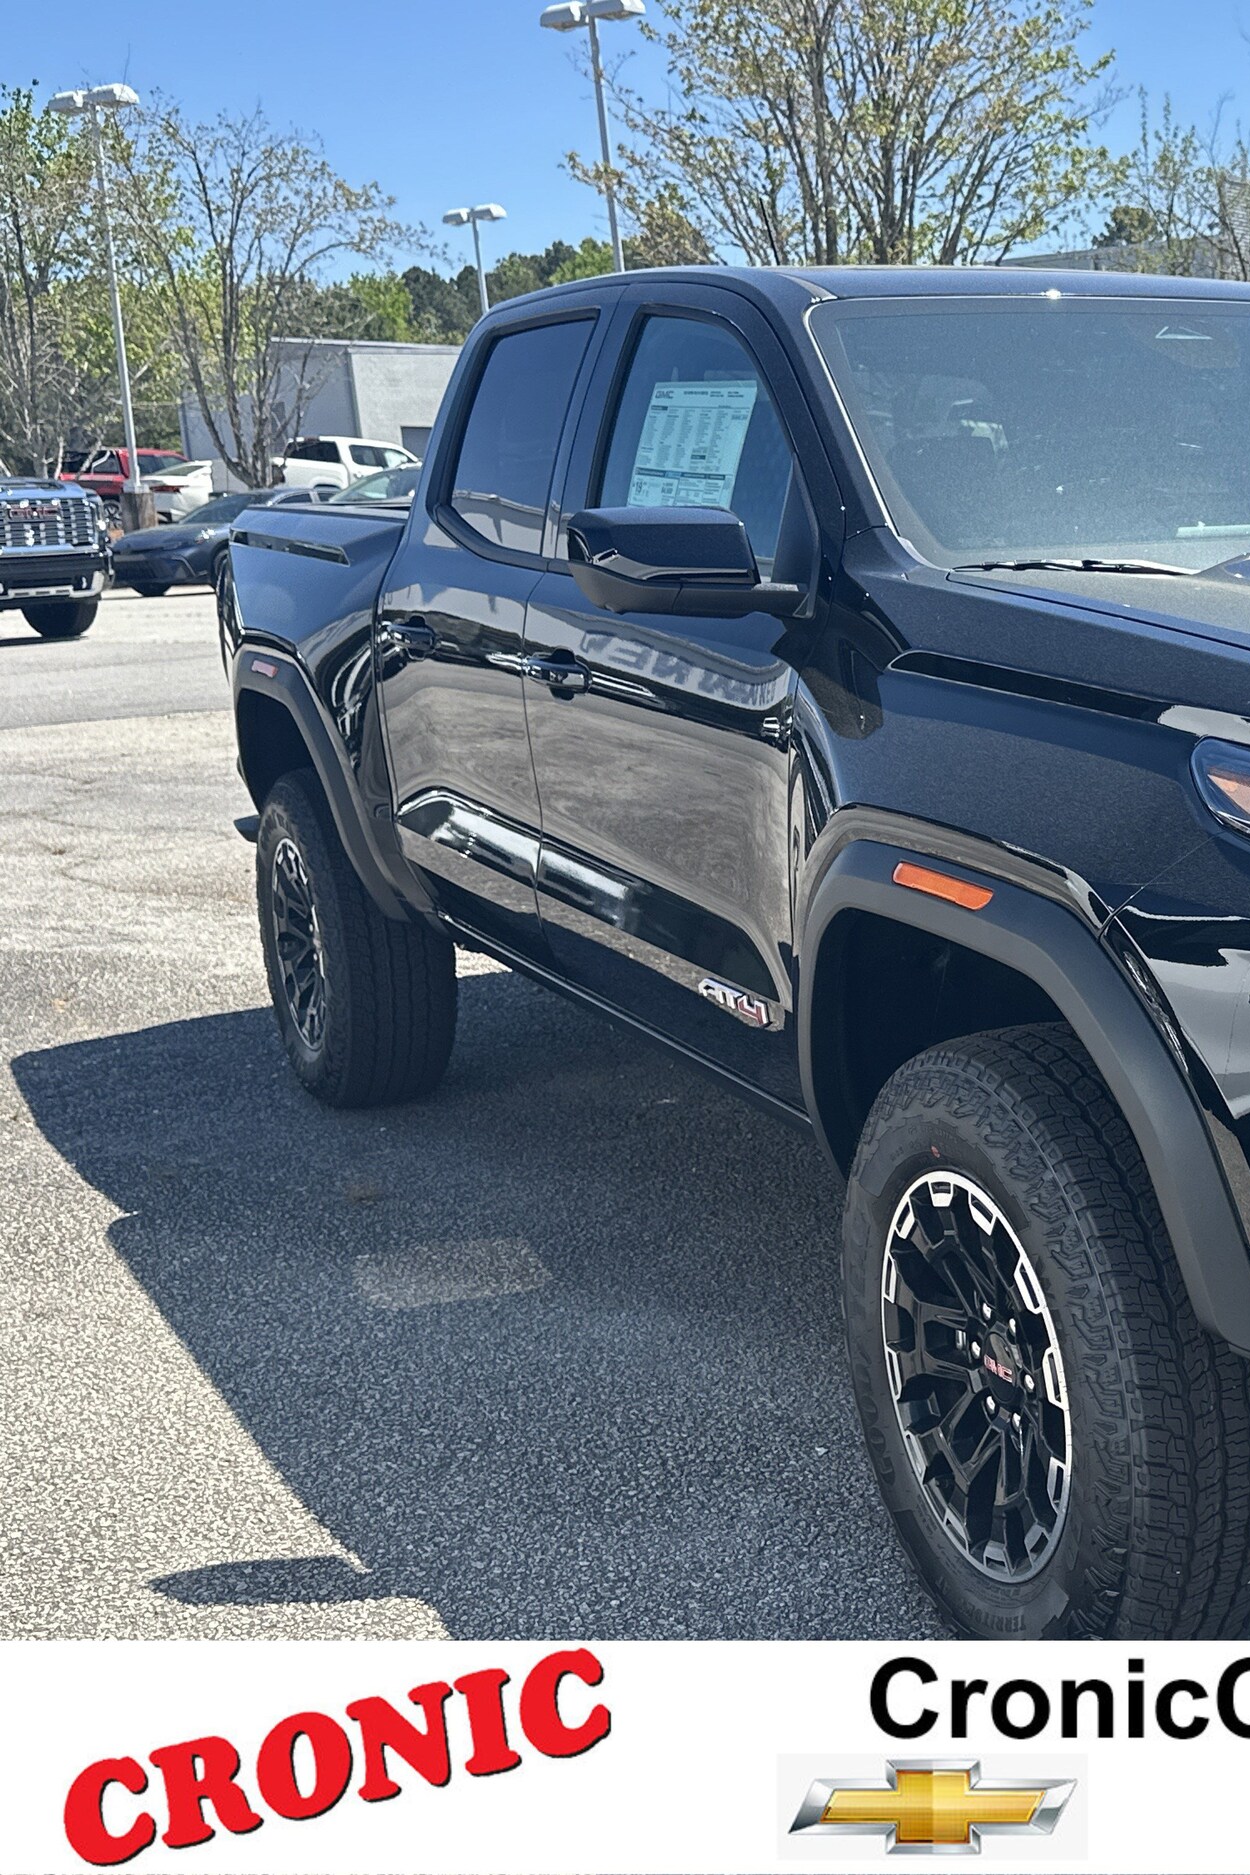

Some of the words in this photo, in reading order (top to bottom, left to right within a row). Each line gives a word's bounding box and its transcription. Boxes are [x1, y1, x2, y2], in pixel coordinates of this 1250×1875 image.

[655, 390, 674, 399] GMC
[698, 978, 769, 1025] AT4
[984, 1354, 1012, 1382] GMC
